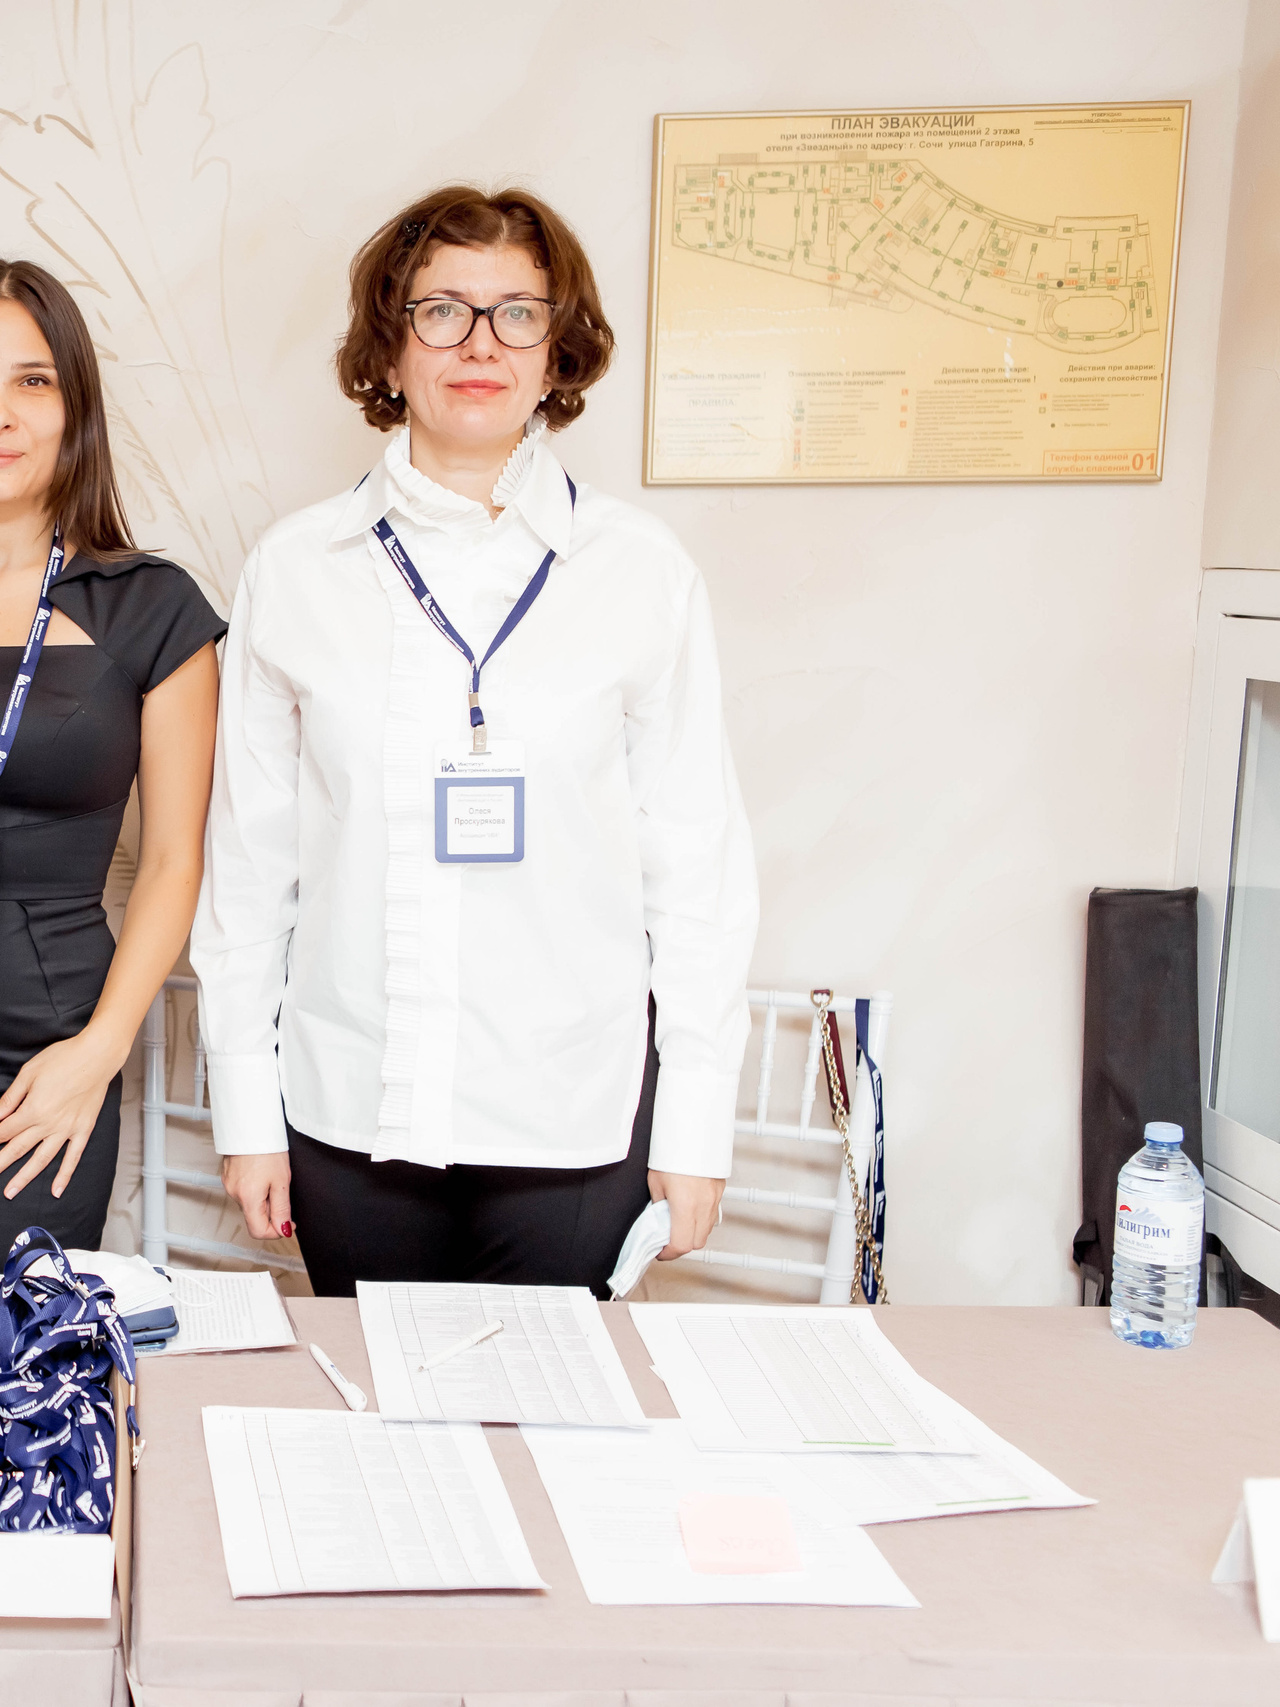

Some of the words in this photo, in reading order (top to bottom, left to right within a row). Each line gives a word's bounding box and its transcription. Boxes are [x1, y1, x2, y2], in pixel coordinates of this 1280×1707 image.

[831, 118, 874, 130] ПЛАН
[880, 115, 974, 129] ЭВАКУАЦИИ
[927, 128, 982, 137] помещений
[870, 142, 906, 151] адресу:
[948, 140, 977, 149] улица
[1050, 454, 1091, 463] Телефон
[1094, 452, 1128, 462] единой
[1132, 453, 1155, 471] 01
[1046, 464, 1083, 474] службы
